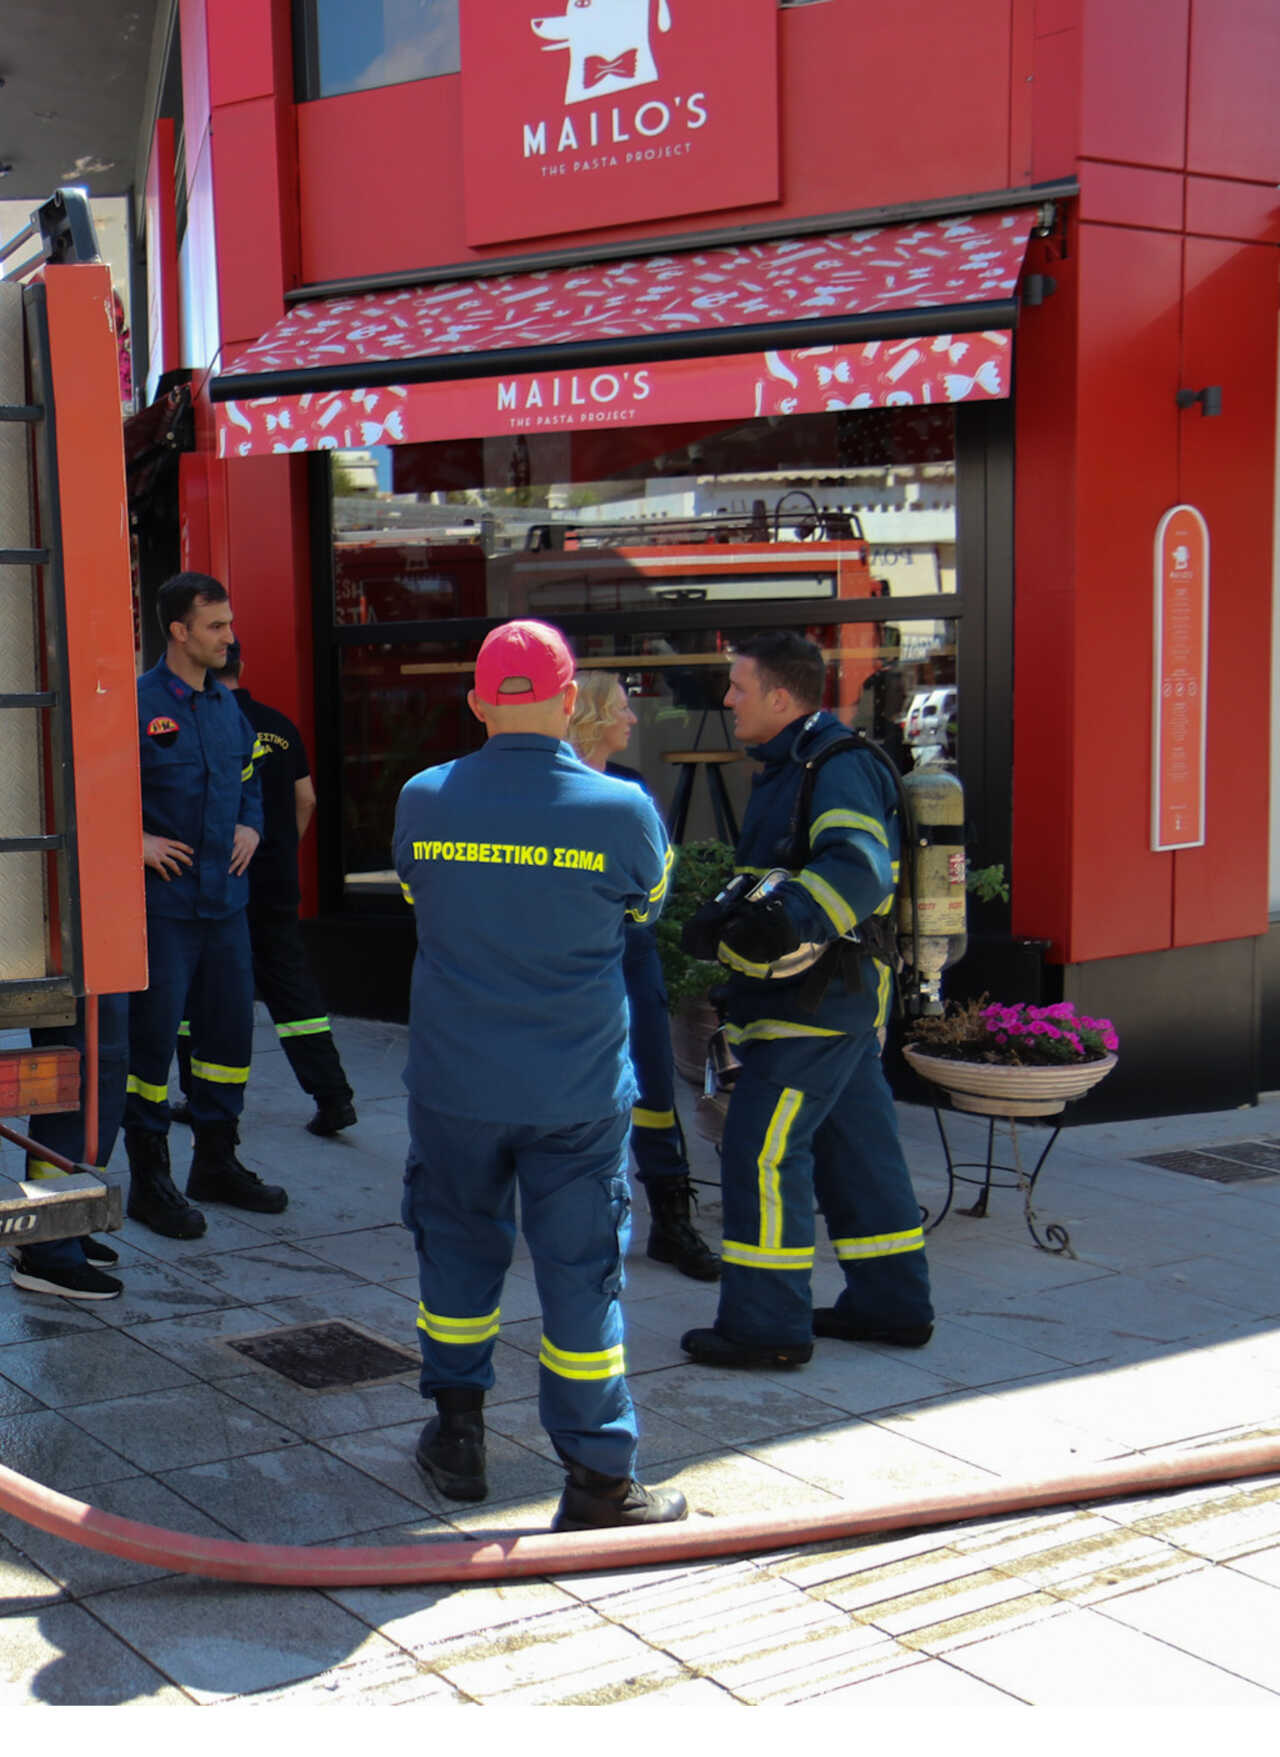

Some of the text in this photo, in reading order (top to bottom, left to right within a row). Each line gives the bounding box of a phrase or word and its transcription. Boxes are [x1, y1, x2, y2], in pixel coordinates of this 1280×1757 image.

[523, 92, 708, 158] MAILO'S
[540, 142, 693, 177] THE PASTA PROJECT
[497, 370, 651, 411] MAILO'S
[509, 409, 636, 428] THE PASTA PROJECT
[412, 841, 605, 872] ΠΥΡΟΣΒΕΣΤΙΚΟ ΣΩΜΑ
